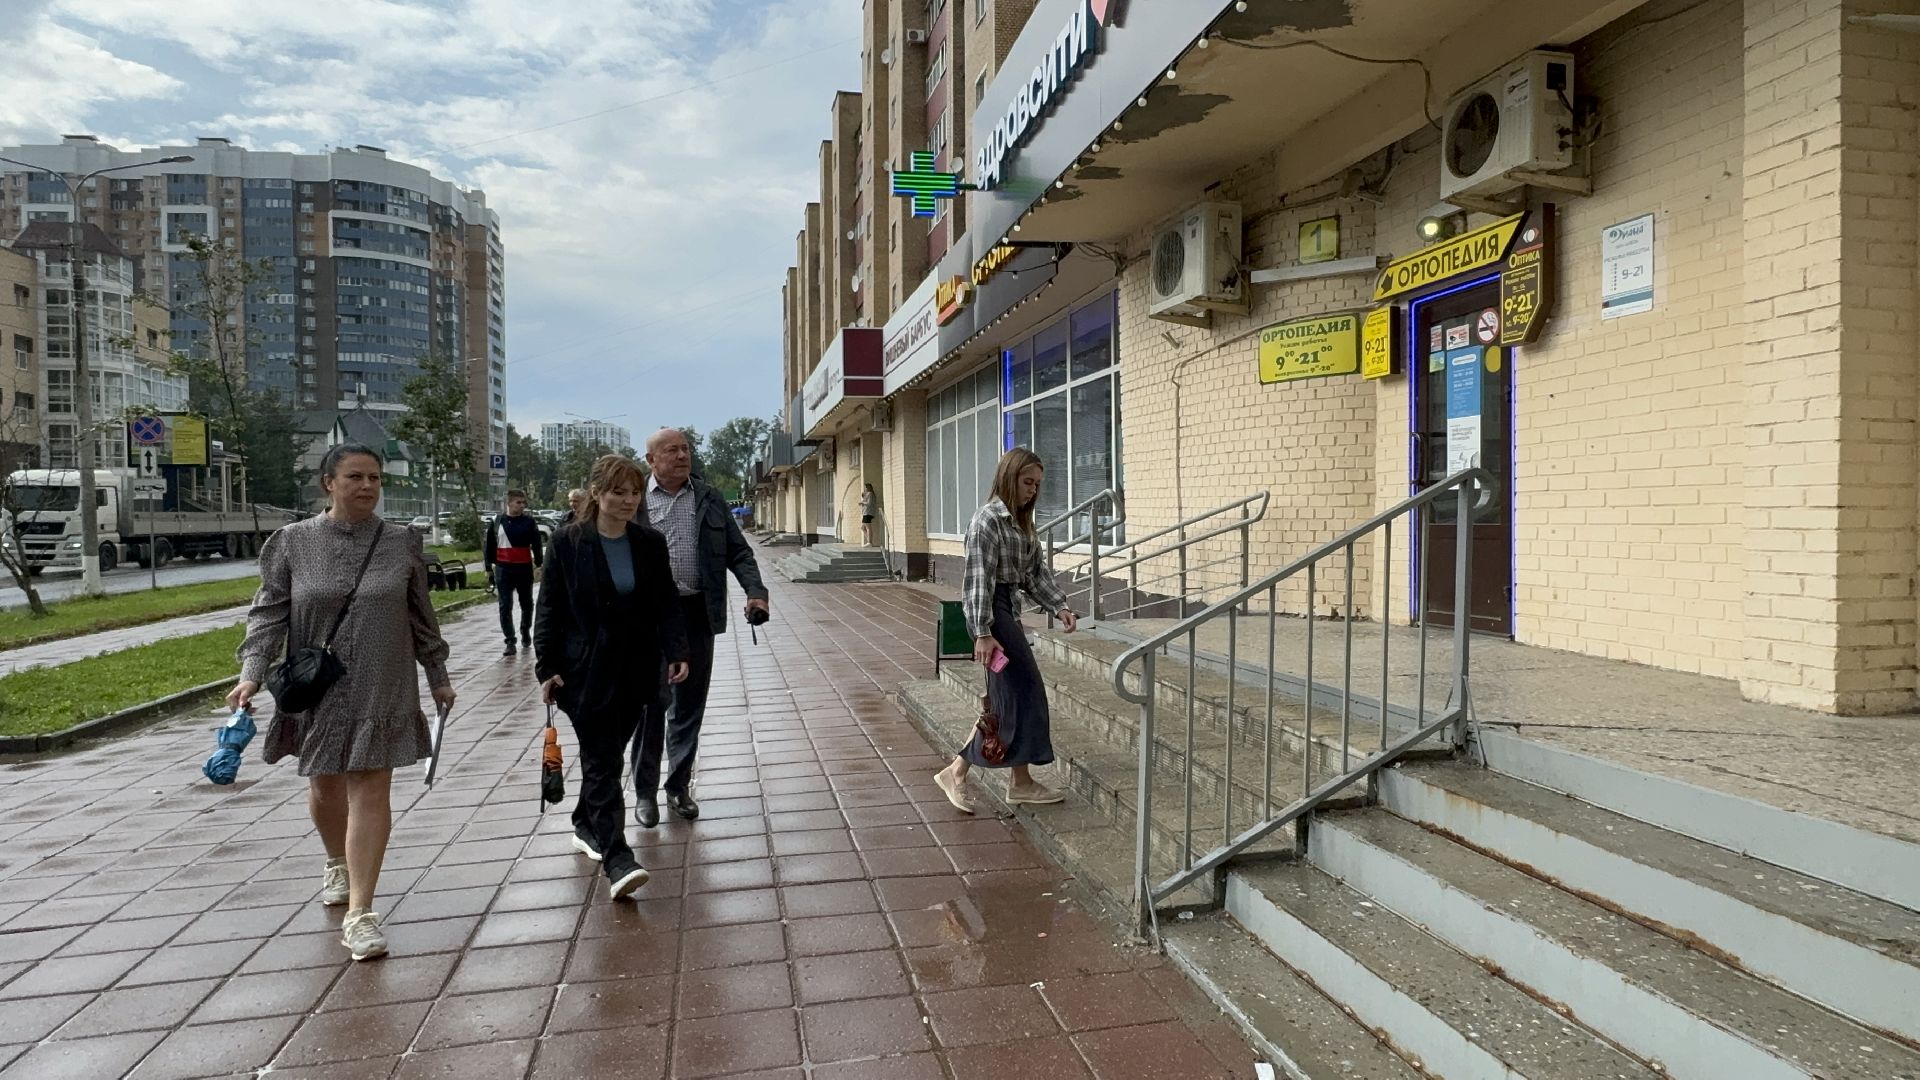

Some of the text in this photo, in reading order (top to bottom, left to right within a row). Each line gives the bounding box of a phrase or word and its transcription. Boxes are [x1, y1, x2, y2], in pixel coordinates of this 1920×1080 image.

[1310, 224, 1322, 252] 1
[1398, 233, 1499, 287] ОРТОПЕДИЯ
[1622, 265, 1644, 279] 9-21
[1262, 319, 1352, 343] ОРТОПЕДИЯ
